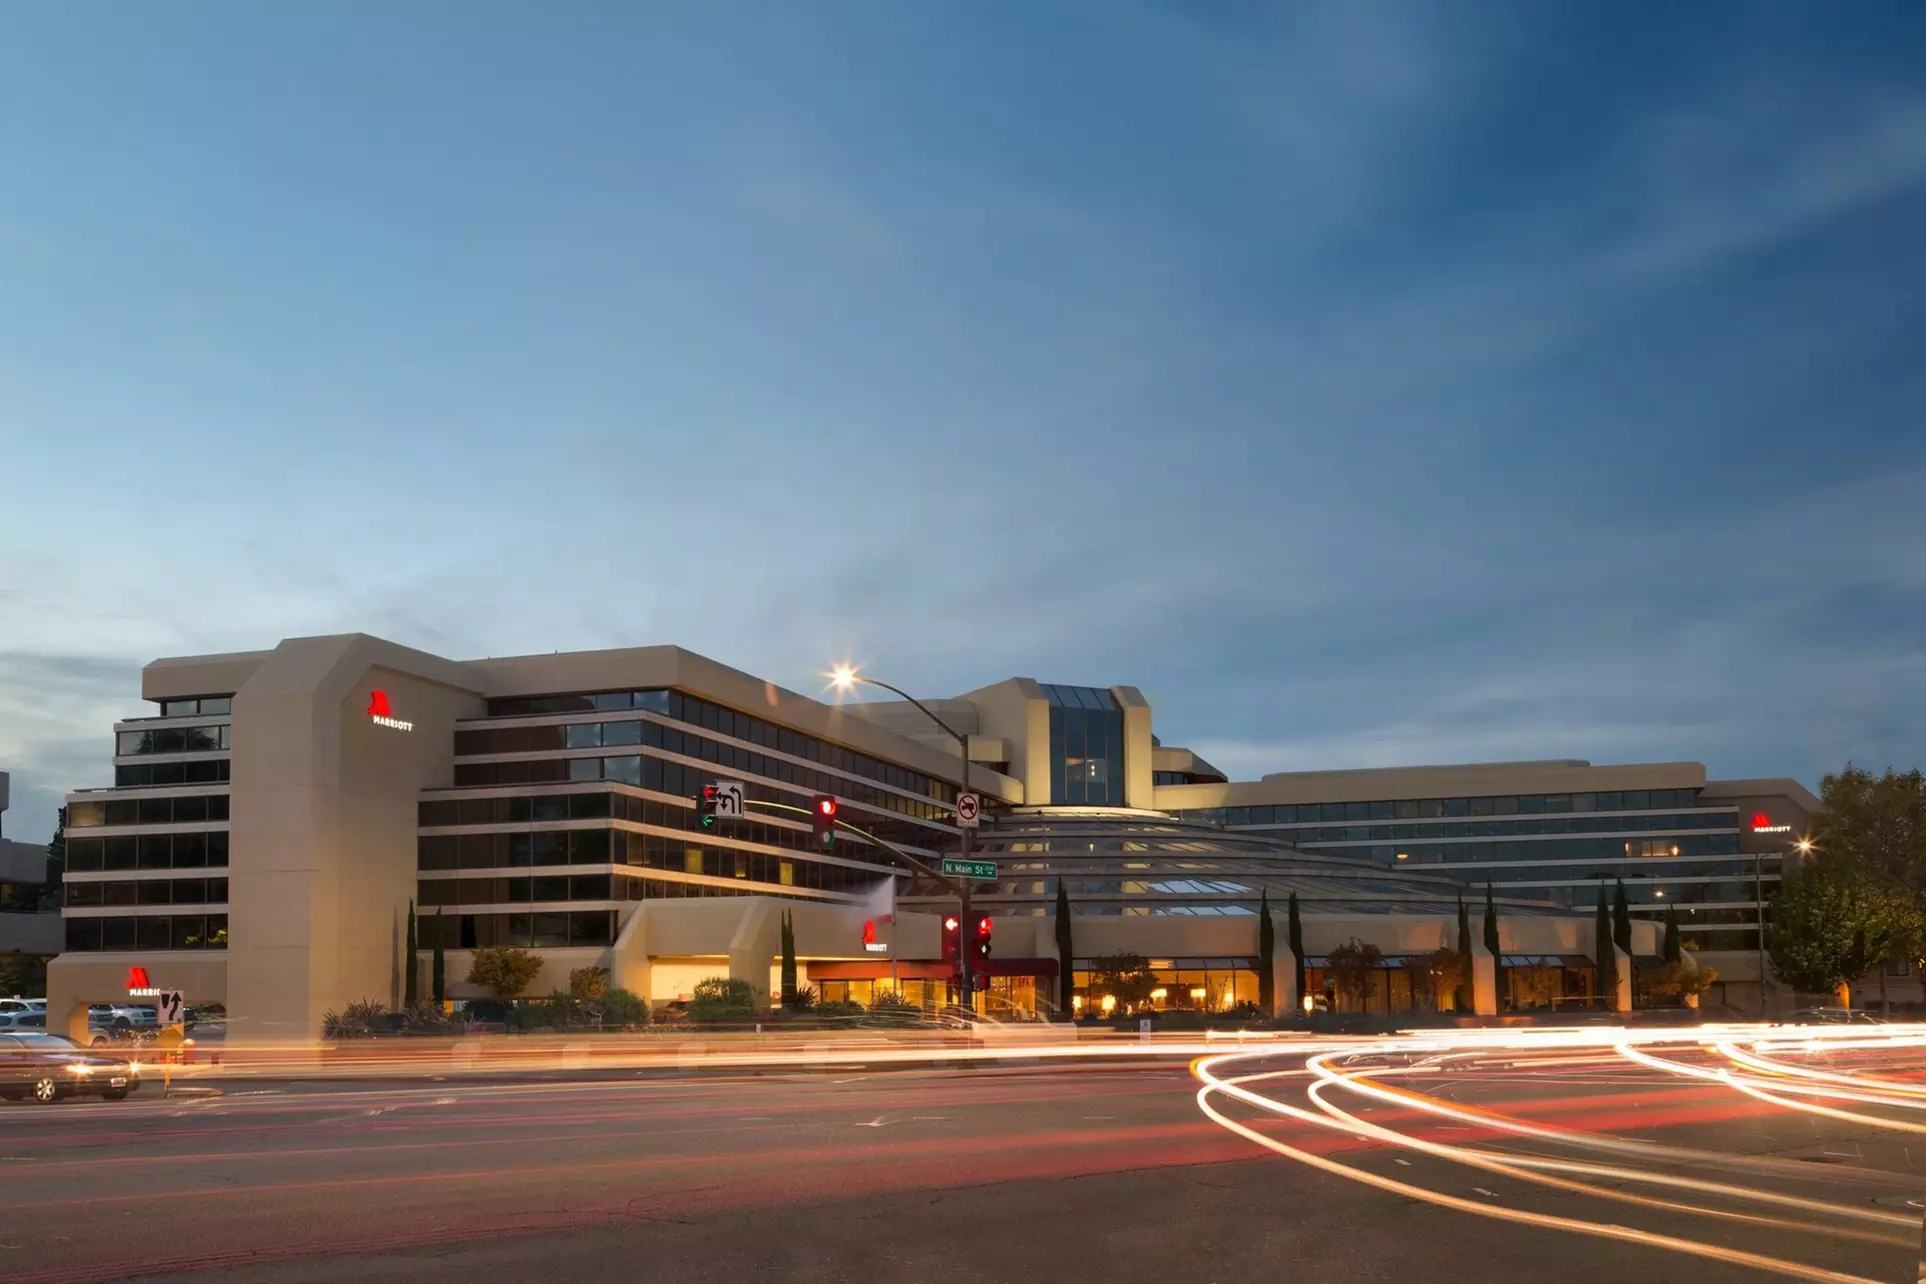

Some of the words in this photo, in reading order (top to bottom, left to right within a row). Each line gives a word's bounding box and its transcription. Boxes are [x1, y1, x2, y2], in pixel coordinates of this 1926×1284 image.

[373, 715, 413, 732] MARRIOTT
[945, 863, 954, 873] N.
[955, 864, 972, 874] Main
[974, 865, 984, 875] St
